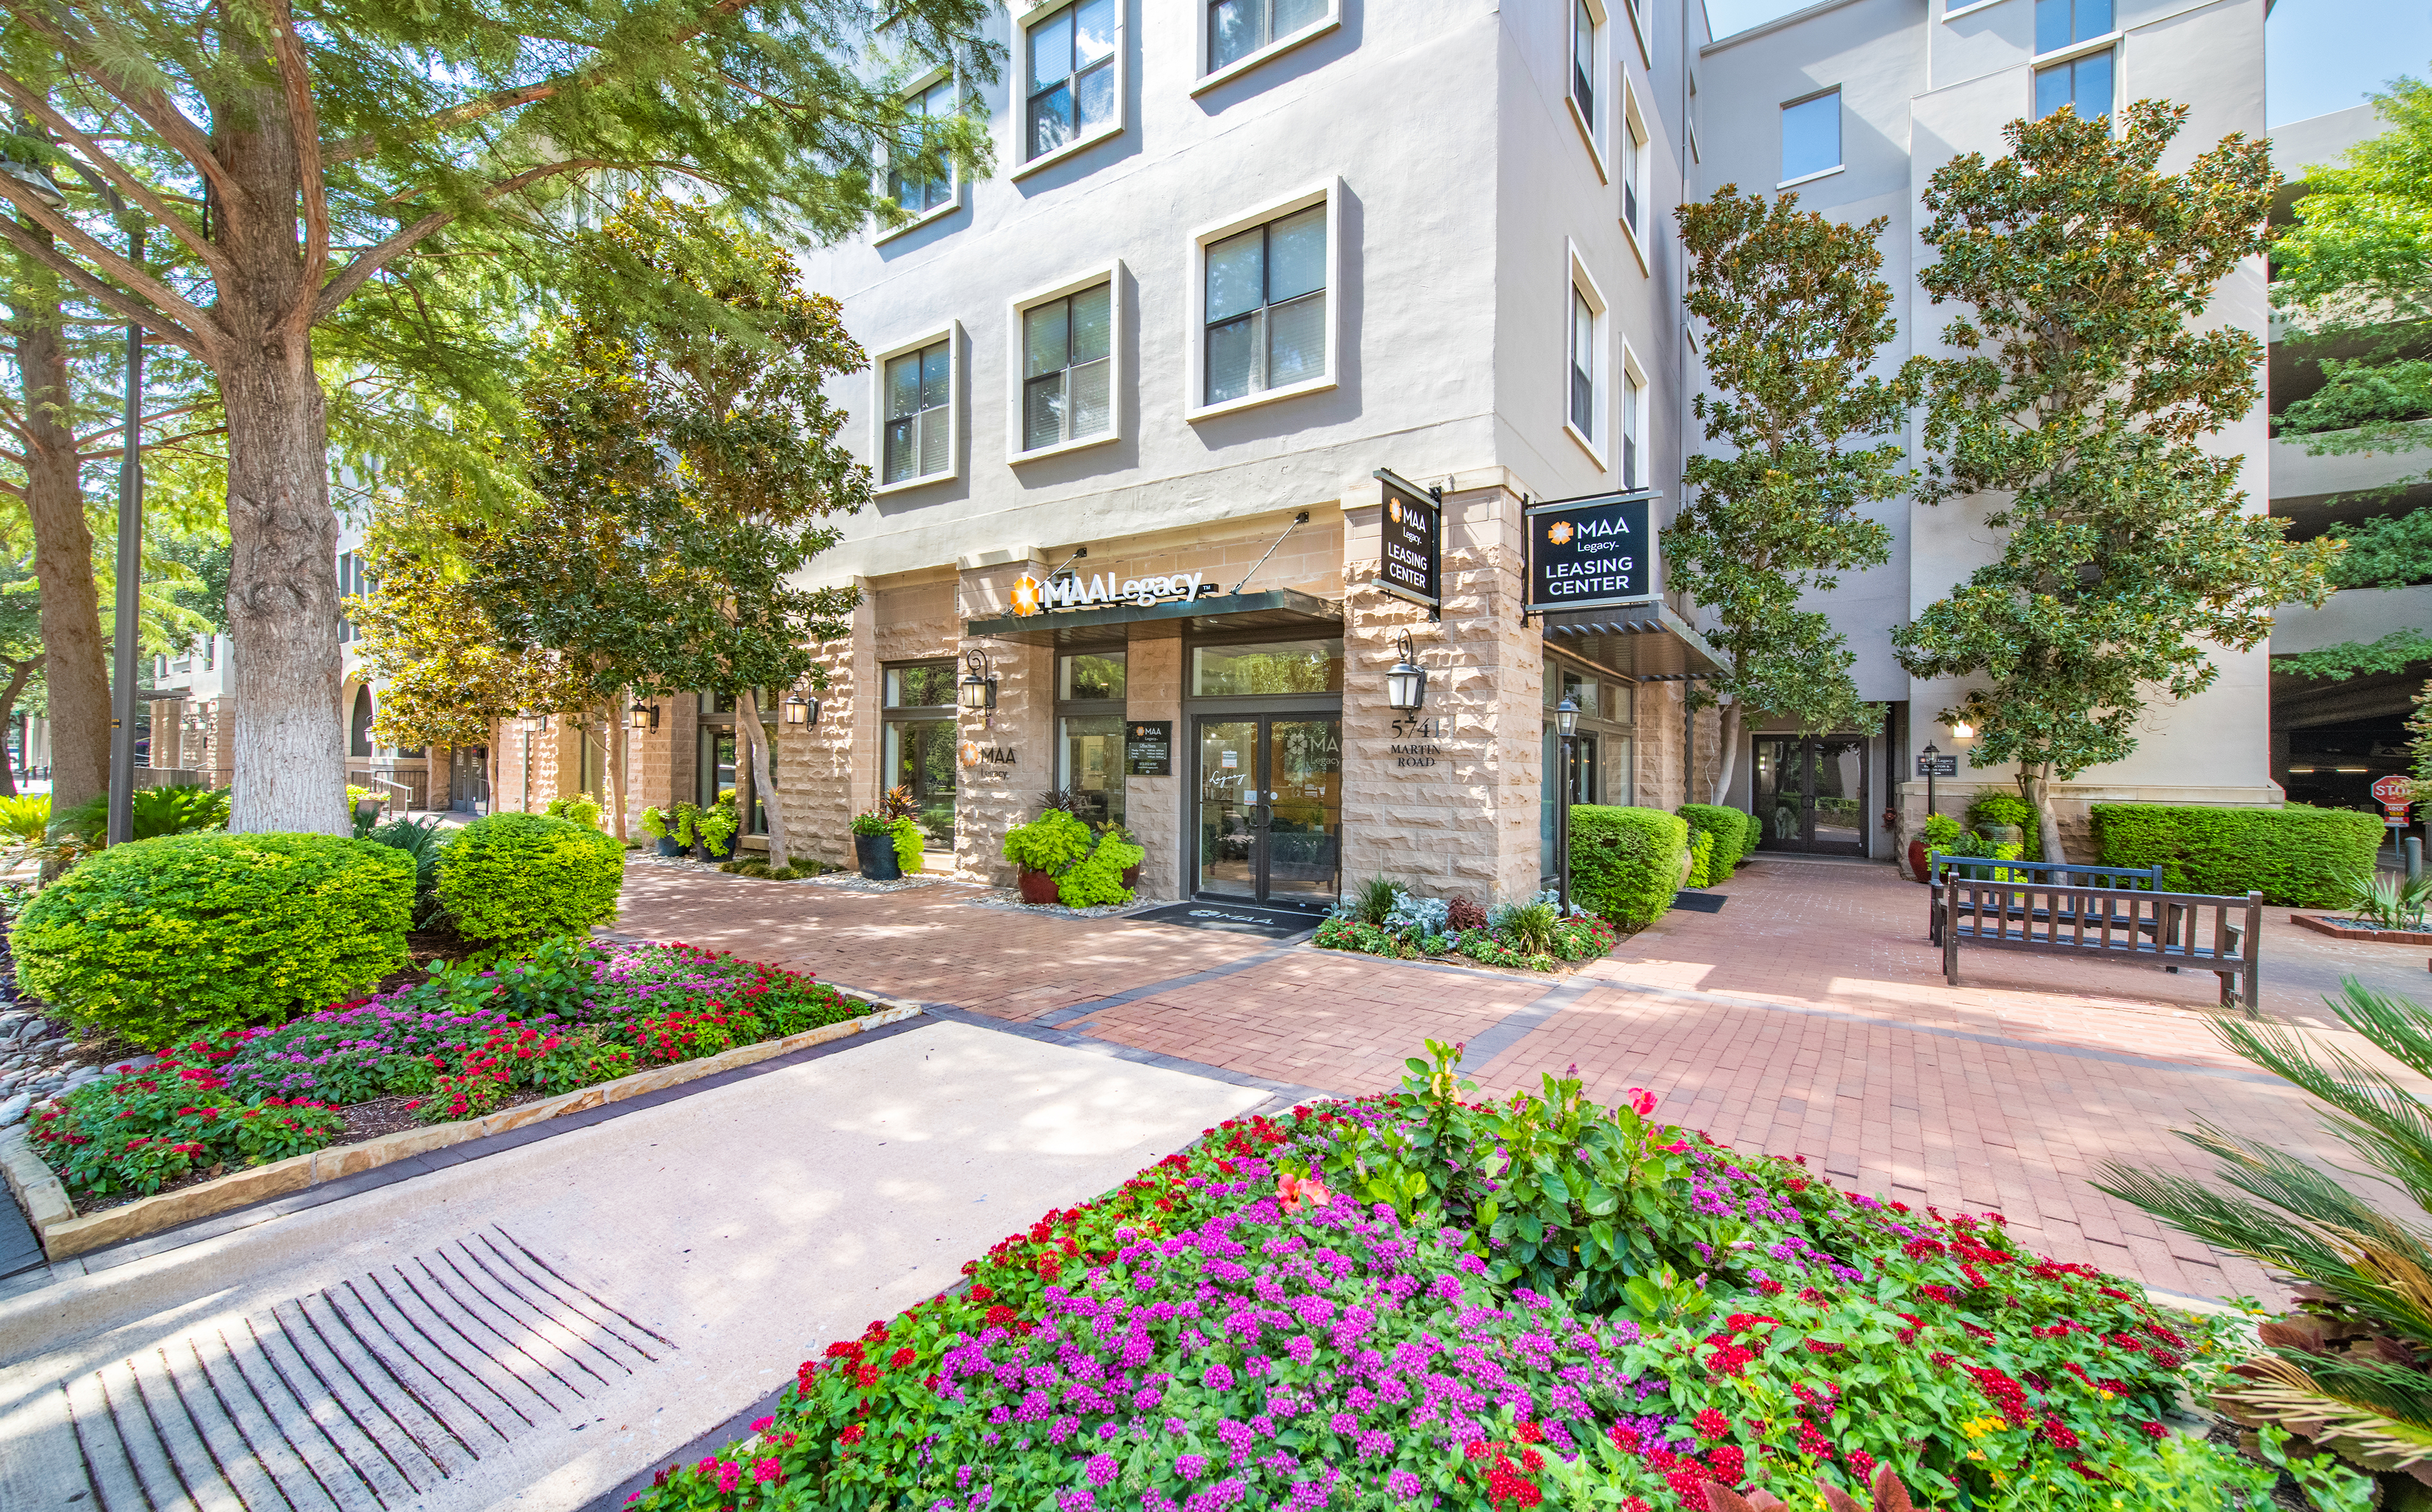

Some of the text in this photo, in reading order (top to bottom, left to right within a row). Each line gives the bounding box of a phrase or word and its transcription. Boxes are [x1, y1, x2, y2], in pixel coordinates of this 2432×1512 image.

[1403, 506, 1426, 532] MAA
[1403, 526, 1421, 545] Legacy
[1577, 517, 1630, 539] MAA
[1388, 541, 1428, 570] LEASING
[1577, 541, 1616, 553] Legacy
[1390, 562, 1426, 589] CENTER
[1546, 557, 1633, 578] LEASING
[1548, 575, 1630, 595] CENTER
[1391, 717, 1441, 740] 5741
[1310, 736, 1340, 752] MA
[1391, 745, 1441, 755] MARTIN
[981, 747, 1016, 764] MAA
[1310, 755, 1340, 767] Legacy
[1398, 757, 1435, 767] ROAD
[981, 767, 1008, 780] Legacy
[1209, 770, 1247, 788] Legacy
[2375, 785, 2407, 796] STO
[1215, 913, 1272, 924] MAA
